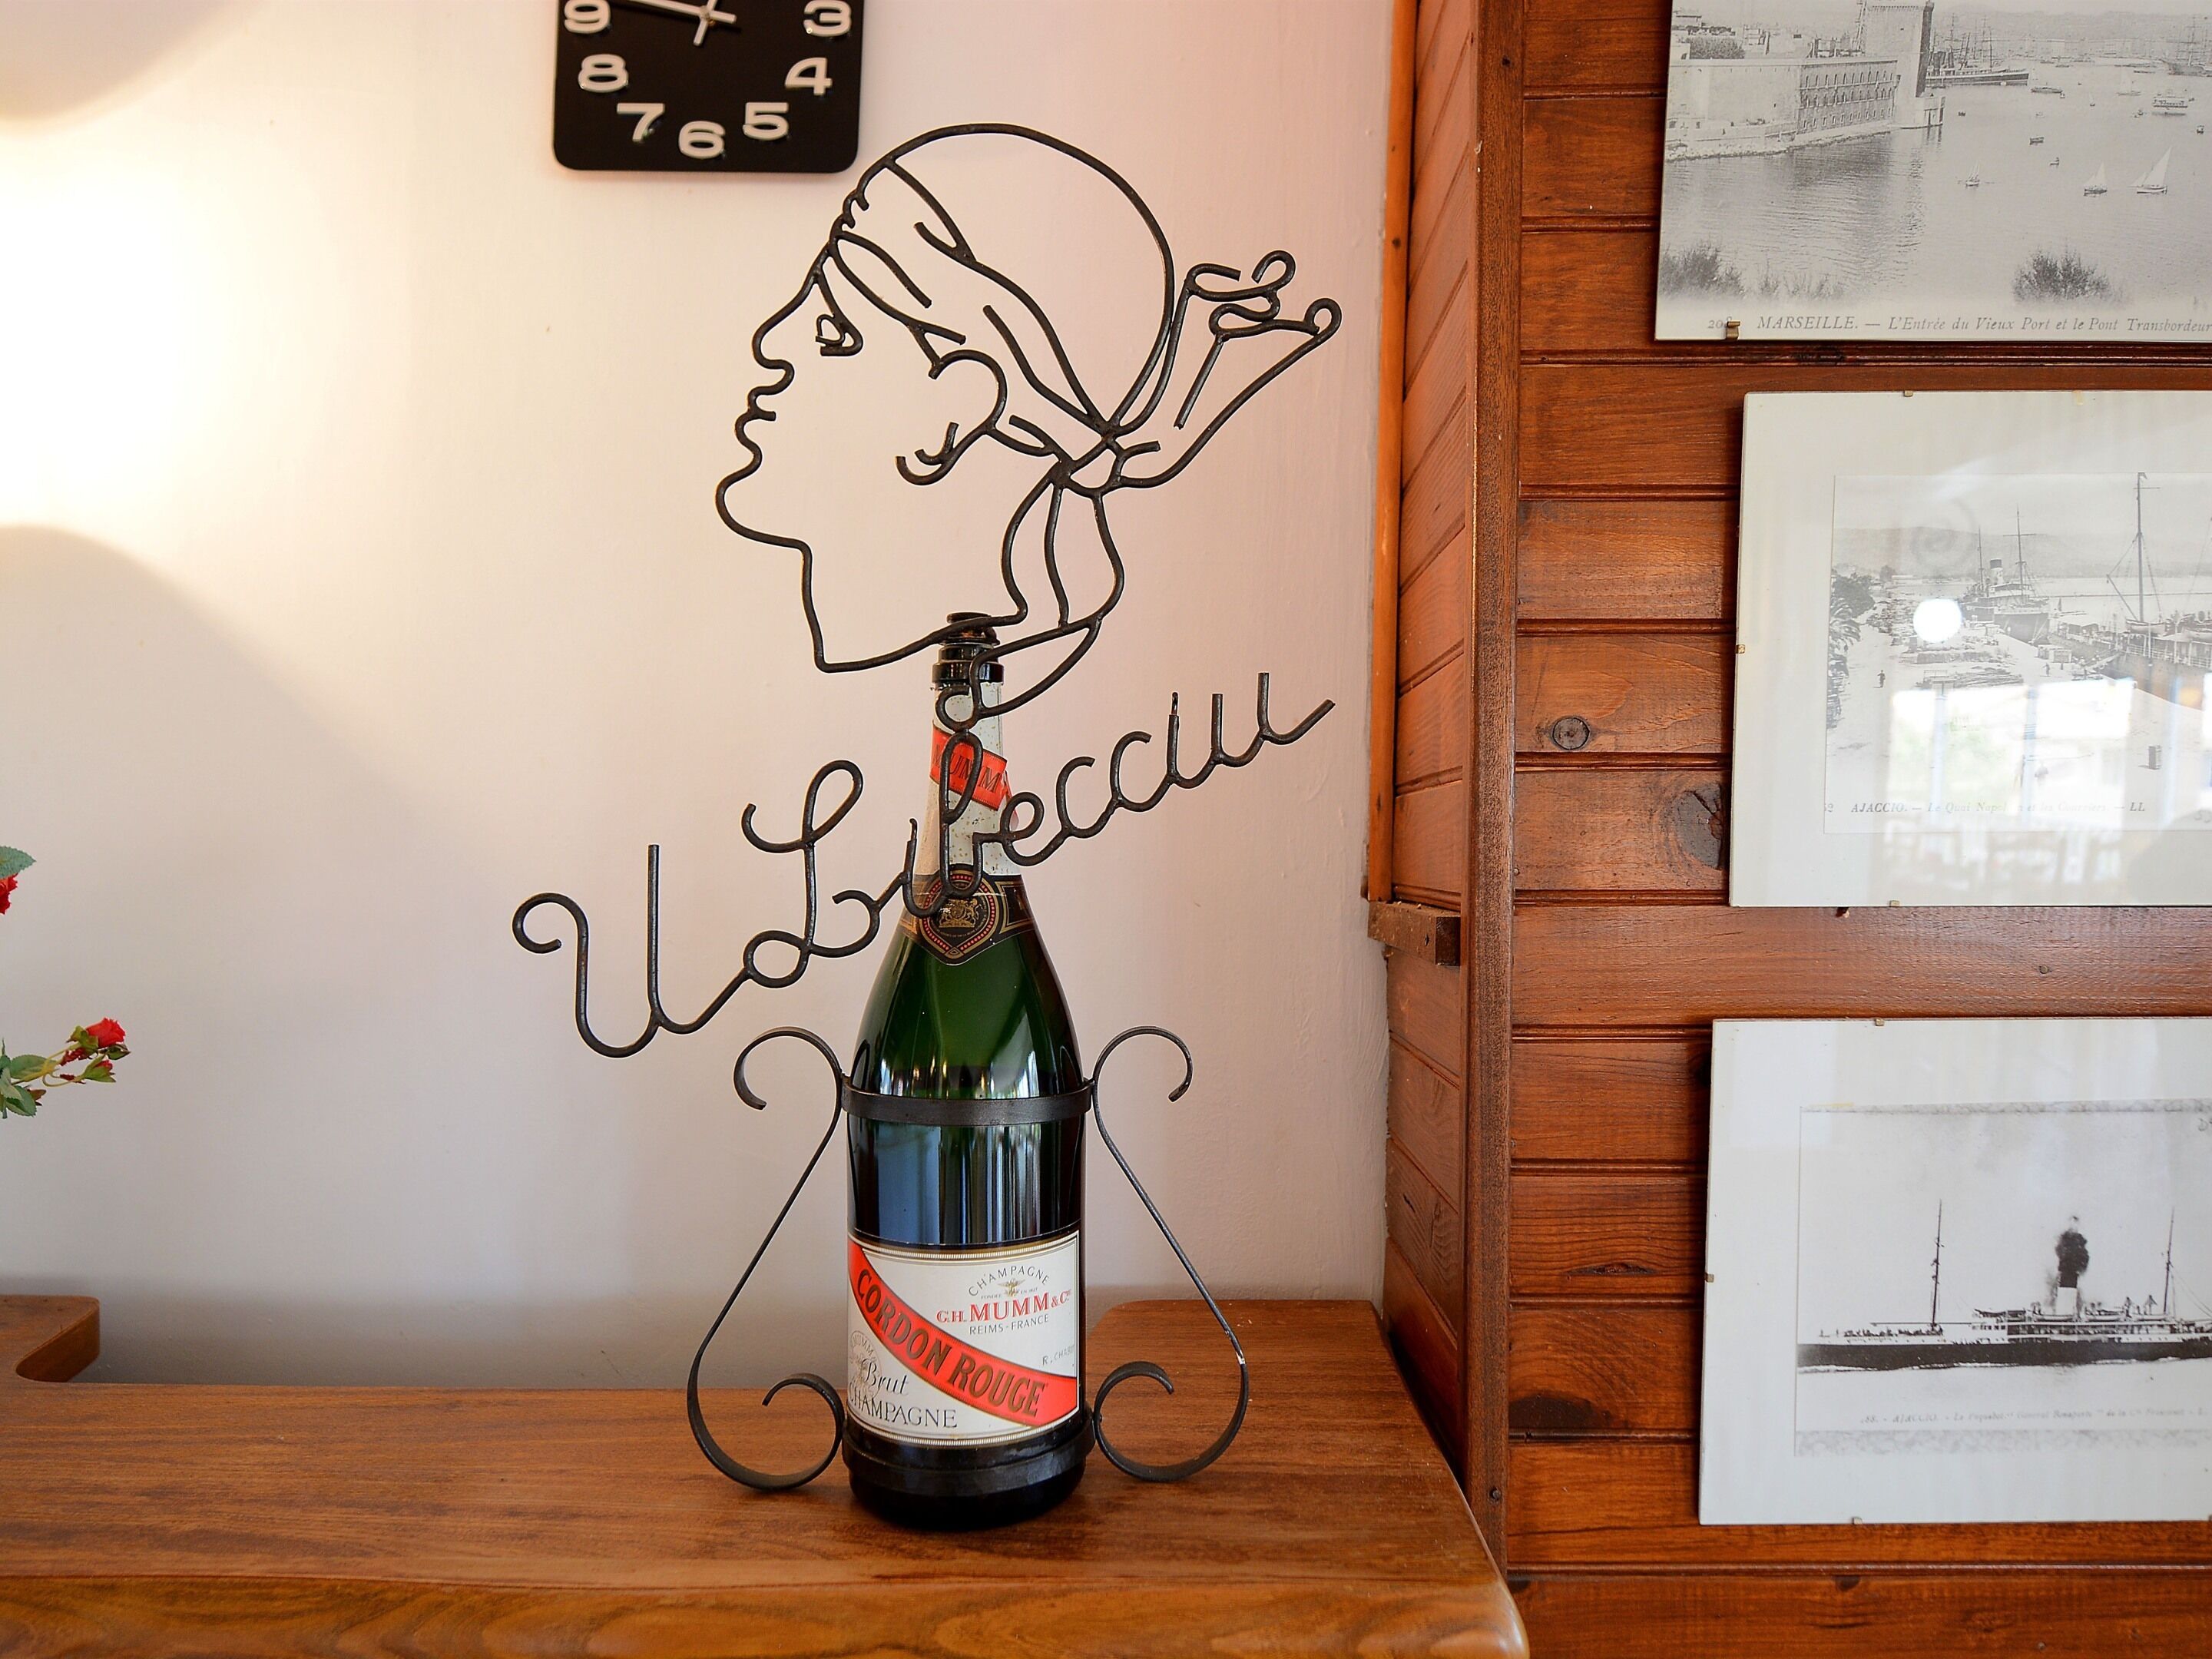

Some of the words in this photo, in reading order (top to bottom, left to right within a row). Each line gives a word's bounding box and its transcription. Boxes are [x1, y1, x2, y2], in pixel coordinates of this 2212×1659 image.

[564, 0, 611, 34] 9
[803, 0, 852, 37] 3
[578, 54, 629, 93] 8
[784, 57, 833, 96] 4
[617, 103, 665, 143] 7
[678, 121, 726, 159] 6
[743, 102, 790, 141] 5
[1757, 315, 1859, 330] MARSEILLE.
[1952, 316, 1969, 331] du
[1975, 316, 2015, 331] Vieux
[2022, 317, 2050, 331] Port
[2056, 318, 2068, 331] et
[2073, 317, 2085, 331] le
[2089, 317, 2119, 331] Pont
[969, 1265, 1050, 1296] CHAMPAGNE
[969, 1323, 1004, 1336] REIMS
[1011, 1313, 1049, 1331] FRANCE
[970, 1291, 1049, 1323] MUMM
[857, 1269, 952, 1378] CORDON
[948, 1351, 1046, 1418] ROUGE
[861, 1358, 909, 1396] Brut
[849, 1381, 958, 1429] CHAMPAGNE
